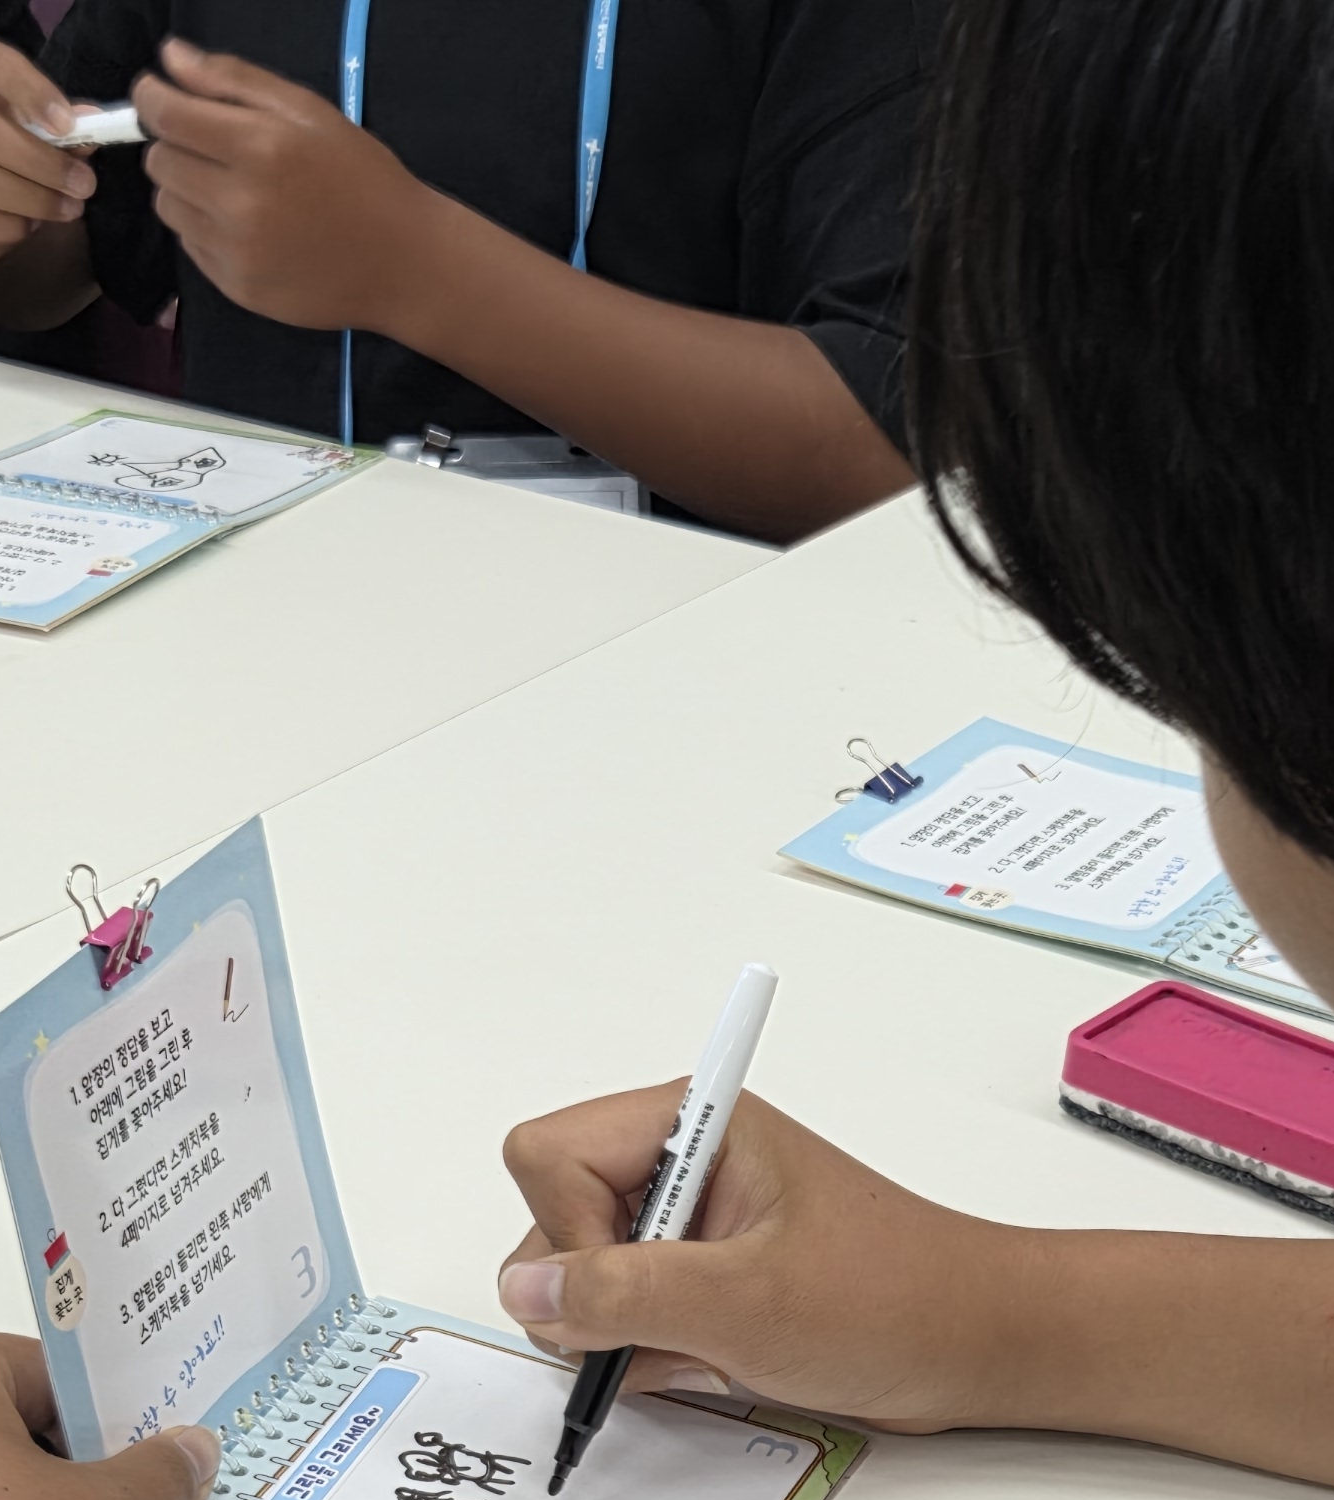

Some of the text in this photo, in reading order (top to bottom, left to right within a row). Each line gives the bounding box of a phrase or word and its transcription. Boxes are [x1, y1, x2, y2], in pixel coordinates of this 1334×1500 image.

[70, 1009, 173, 1105] 1. 앞장의 정답을 보고
[91, 1028, 192, 1124] 아래에 그림을 그린 후
[96, 1068, 187, 1160] 집게를 꽂아주세요!
[666, 1184, 682, 1207] 선명한
[676, 1166, 689, 1182] 색상
[685, 1128, 704, 1160] 깨끗하게
[699, 1103, 714, 1127] 지워짐
[99, 1112, 219, 1232] 2. 다 그렸다면 스케치북을
[121, 1148, 225, 1248] 4페이지로 넘겨주세요.
[55, 1268, 75, 1295] 집게
[73, 1286, 84, 1305] 곳
[120, 1171, 271, 1324] 3. 알림음이 들리면 왼쪽 사람에게
[141, 1245, 235, 1345] 스케치북을 넘기세요.
[164, 1385, 177, 1408] 수
[179, 1314, 225, 1390] 있어요!!
[286, 1463, 337, 1500] 그림을
